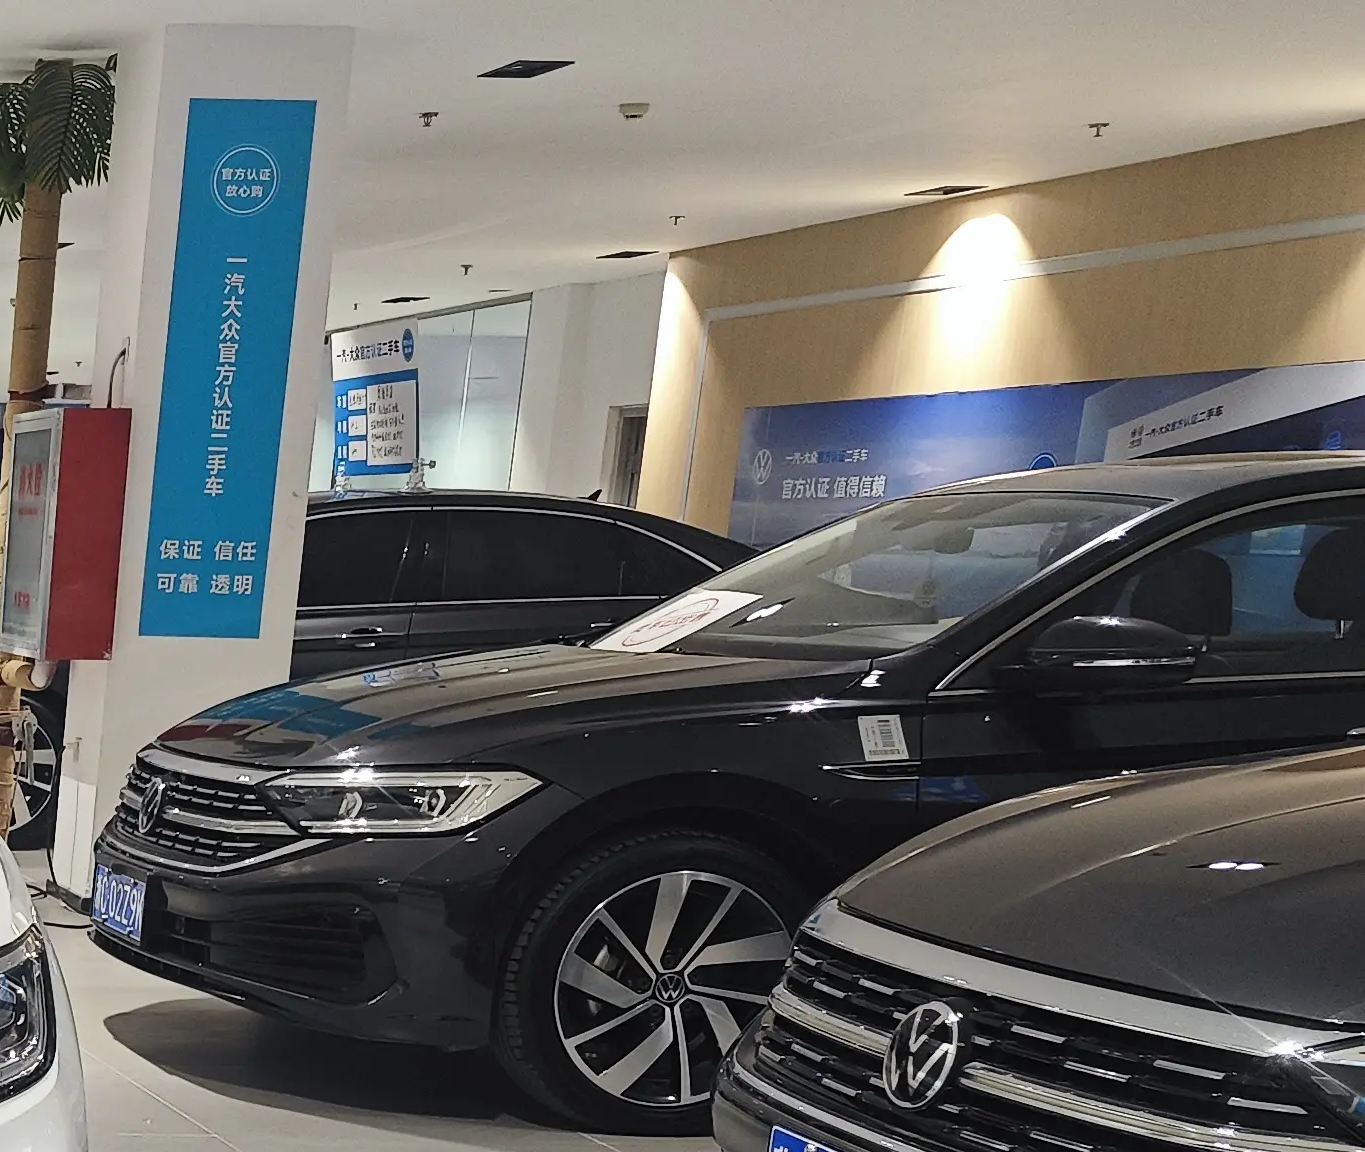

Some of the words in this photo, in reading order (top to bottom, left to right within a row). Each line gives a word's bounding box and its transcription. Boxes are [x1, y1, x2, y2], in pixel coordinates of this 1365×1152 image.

[221, 166, 272, 181] 官方认证
[225, 184, 263, 199] 放心购
[203, 256, 248, 497] 一汽大众官方认证二手车
[781, 476, 831, 500] 官方认证
[833, 474, 887, 498] 值得信赖
[159, 540, 202, 561] 保证
[214, 540, 257, 562] 信任
[156, 572, 199, 595] 可靠
[209, 573, 253, 596] 透明
